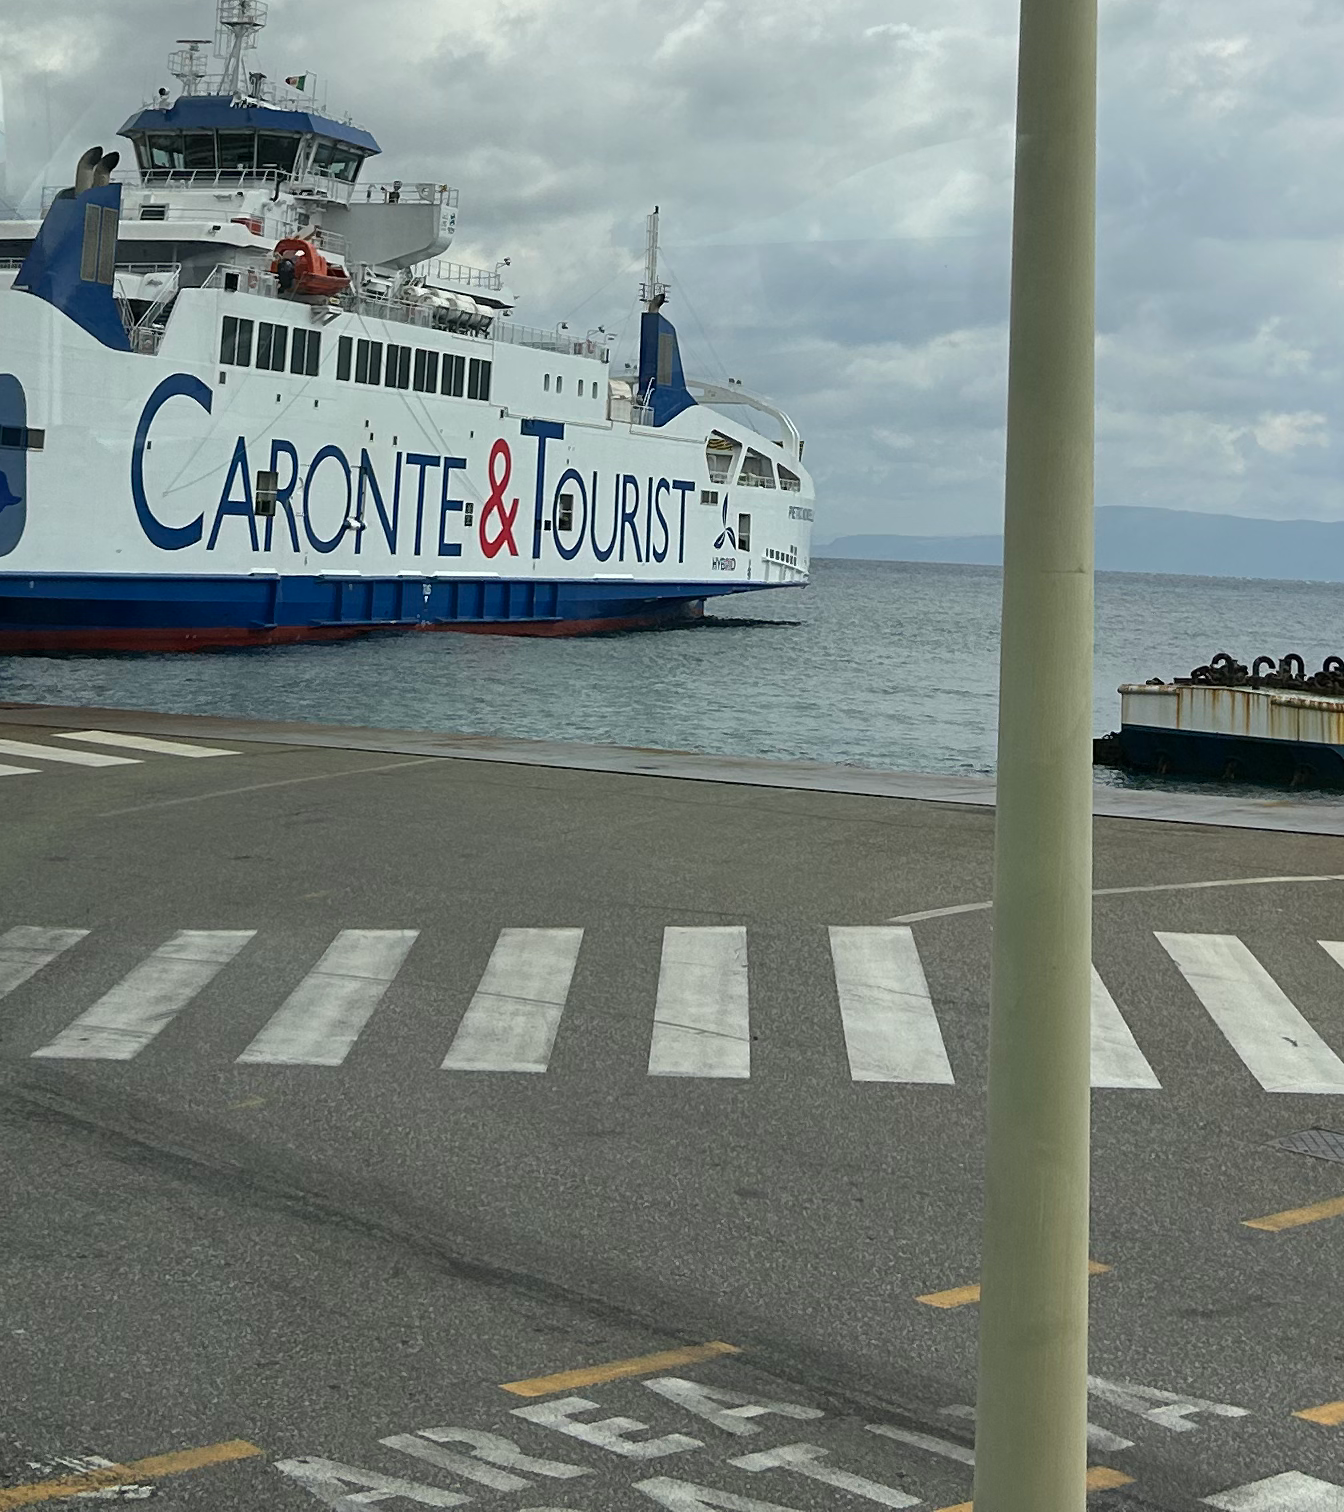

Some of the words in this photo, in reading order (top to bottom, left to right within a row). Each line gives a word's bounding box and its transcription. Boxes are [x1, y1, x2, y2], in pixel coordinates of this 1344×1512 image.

[131, 372, 468, 557] CARONTE
[479, 438, 520, 559] &
[520, 418, 696, 563] TOURIST
[273, 1376, 824, 1512] AREA
